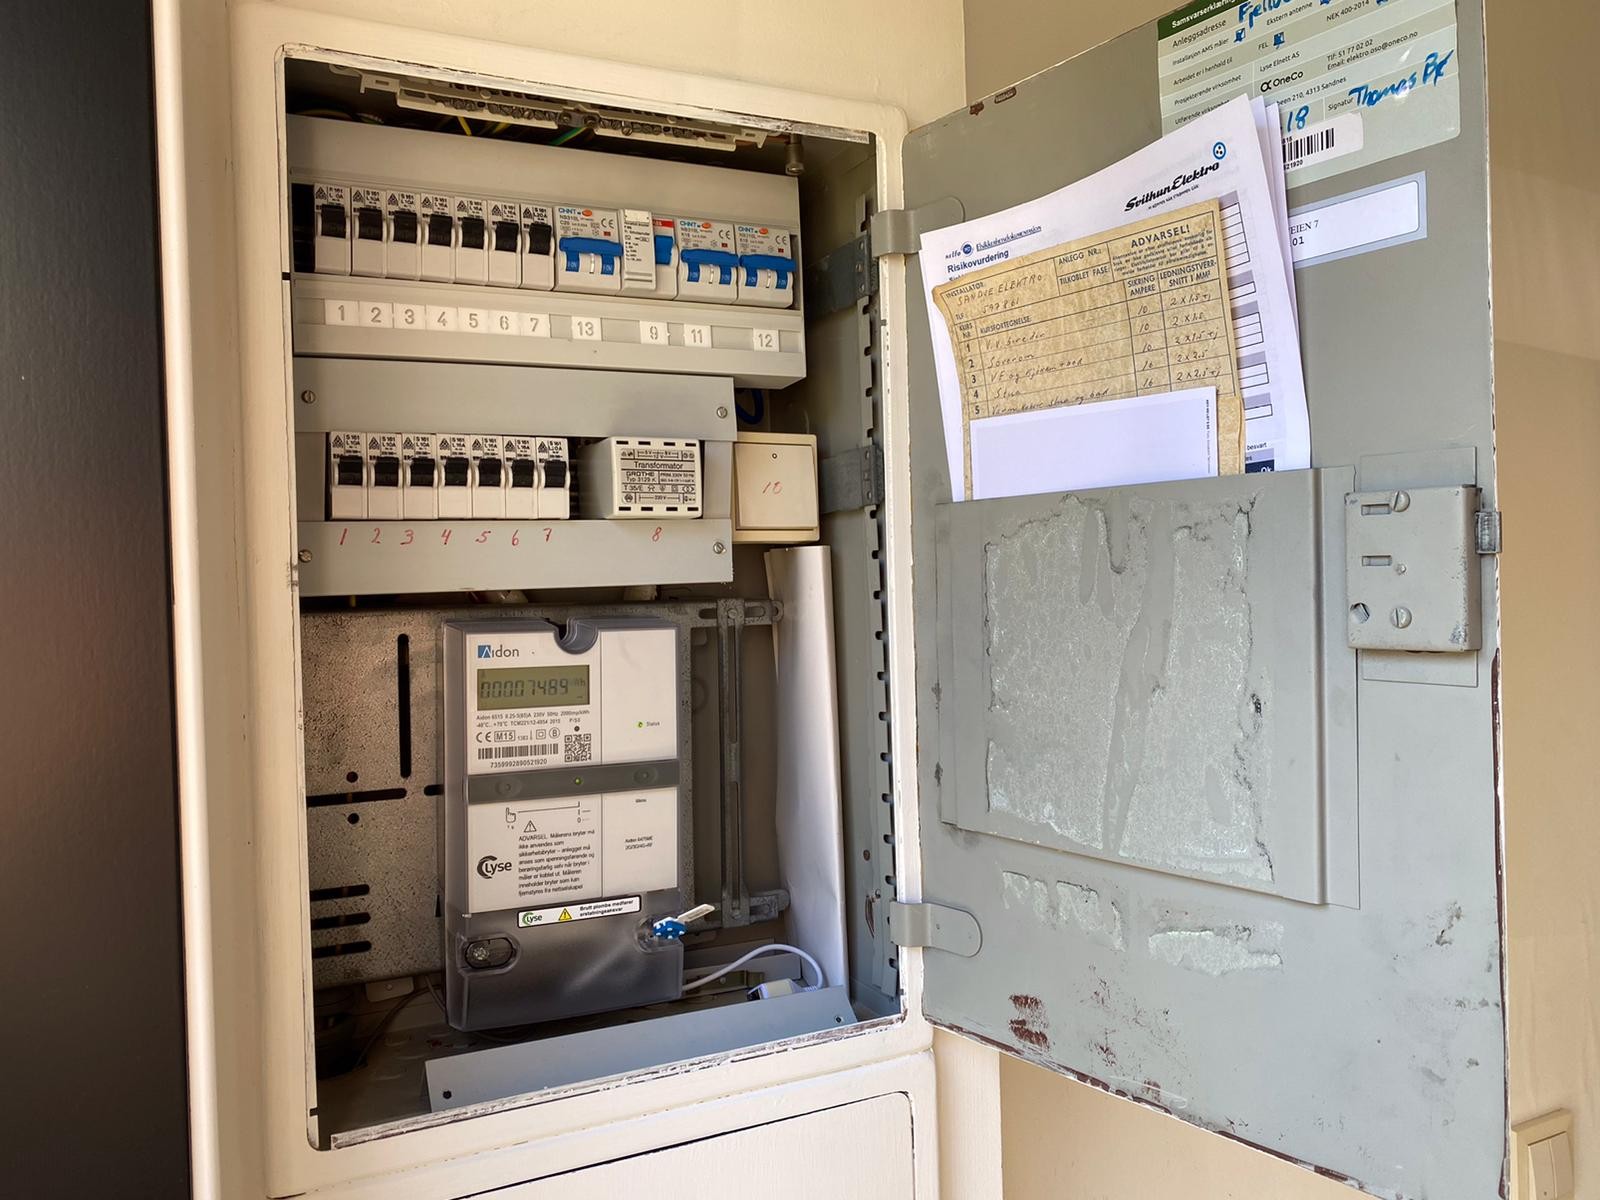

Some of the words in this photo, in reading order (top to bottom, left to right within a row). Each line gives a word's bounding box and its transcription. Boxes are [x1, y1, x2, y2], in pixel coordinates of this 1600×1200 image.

[1266, 10, 1288, 26] Ekstern
[1289, 2, 1313, 16] antenne
[1326, 10, 1340, 21] NEK
[1340, 0, 1370, 15] 400-2014
[1172, 20, 1227, 48] Anleggsadresse
[1201, 45, 1214, 55] AMS
[1258, 42, 1269, 51] FEL
[1338, 50, 1347, 58] 51
[1347, 46, 1355, 55] 77
[1355, 42, 1364, 51] 02
[1364, 38, 1374, 50] 02
[1259, 61, 1272, 72] Lyse
[1273, 54, 1291, 67] Elnett
[1291, 51, 1301, 60] AS
[1326, 58, 1346, 71] Email:
[1272, 71, 1304, 87] OneCo
[1305, 86, 1321, 97] 4313
[1321, 76, 1347, 90] Sandnes
[1327, 97, 1354, 112] Signatur
[1131, 224, 1191, 248] ADVARSEL!
[947, 249, 1009, 273] Risikovurdering
[1058, 253, 1085, 265] ANLEGG
[1159, 258, 1217, 281] LEDNINGSTVERR-
[1060, 271, 1090, 285] TILKOBLET
[1127, 274, 1156, 288] SIKRING
[1168, 276, 1189, 287] SNITT
[1129, 285, 1156, 298] AMPERE
[338, 305, 345, 321] 1
[371, 306, 382, 323] 2
[404, 308, 415, 325] 3
[1137, 305, 1149, 315] 10
[437, 311, 448, 327] 4
[469, 313, 479, 329] 5
[499, 315, 510, 331] 6
[530, 317, 540, 333] 7
[959, 322, 973, 331] KURS
[577, 320, 594, 337] 13
[649, 325, 658, 341] 9
[690, 328, 703, 344] 11
[1139, 323, 1150, 333] 10
[757, 333, 774, 349] 12
[966, 344, 971, 353] 1
[1142, 343, 1153, 353] 10
[968, 360, 975, 369] 2
[971, 374, 977, 384] 3
[973, 389, 979, 399] 4
[975, 406, 980, 415] 5
[633, 460, 684, 470] Transformator
[339, 527, 348, 545] 1
[371, 527, 382, 544] 2
[400, 528, 415, 545] 3
[440, 528, 452, 545] 4
[475, 530, 492, 544] 5
[511, 529, 520, 546] 6
[543, 527, 552, 542] 7
[652, 526, 662, 542] 8
[477, 644, 520, 659] Aidon
[480, 678, 569, 699] 00007489
[495, 731, 514, 741] M15
[484, 859, 513, 876] Lyse
[572, 860, 587, 868] bryter
[593, 902, 612, 910] plombe
[612, 899, 634, 907] medfører
[526, 914, 543, 924] Lyse
